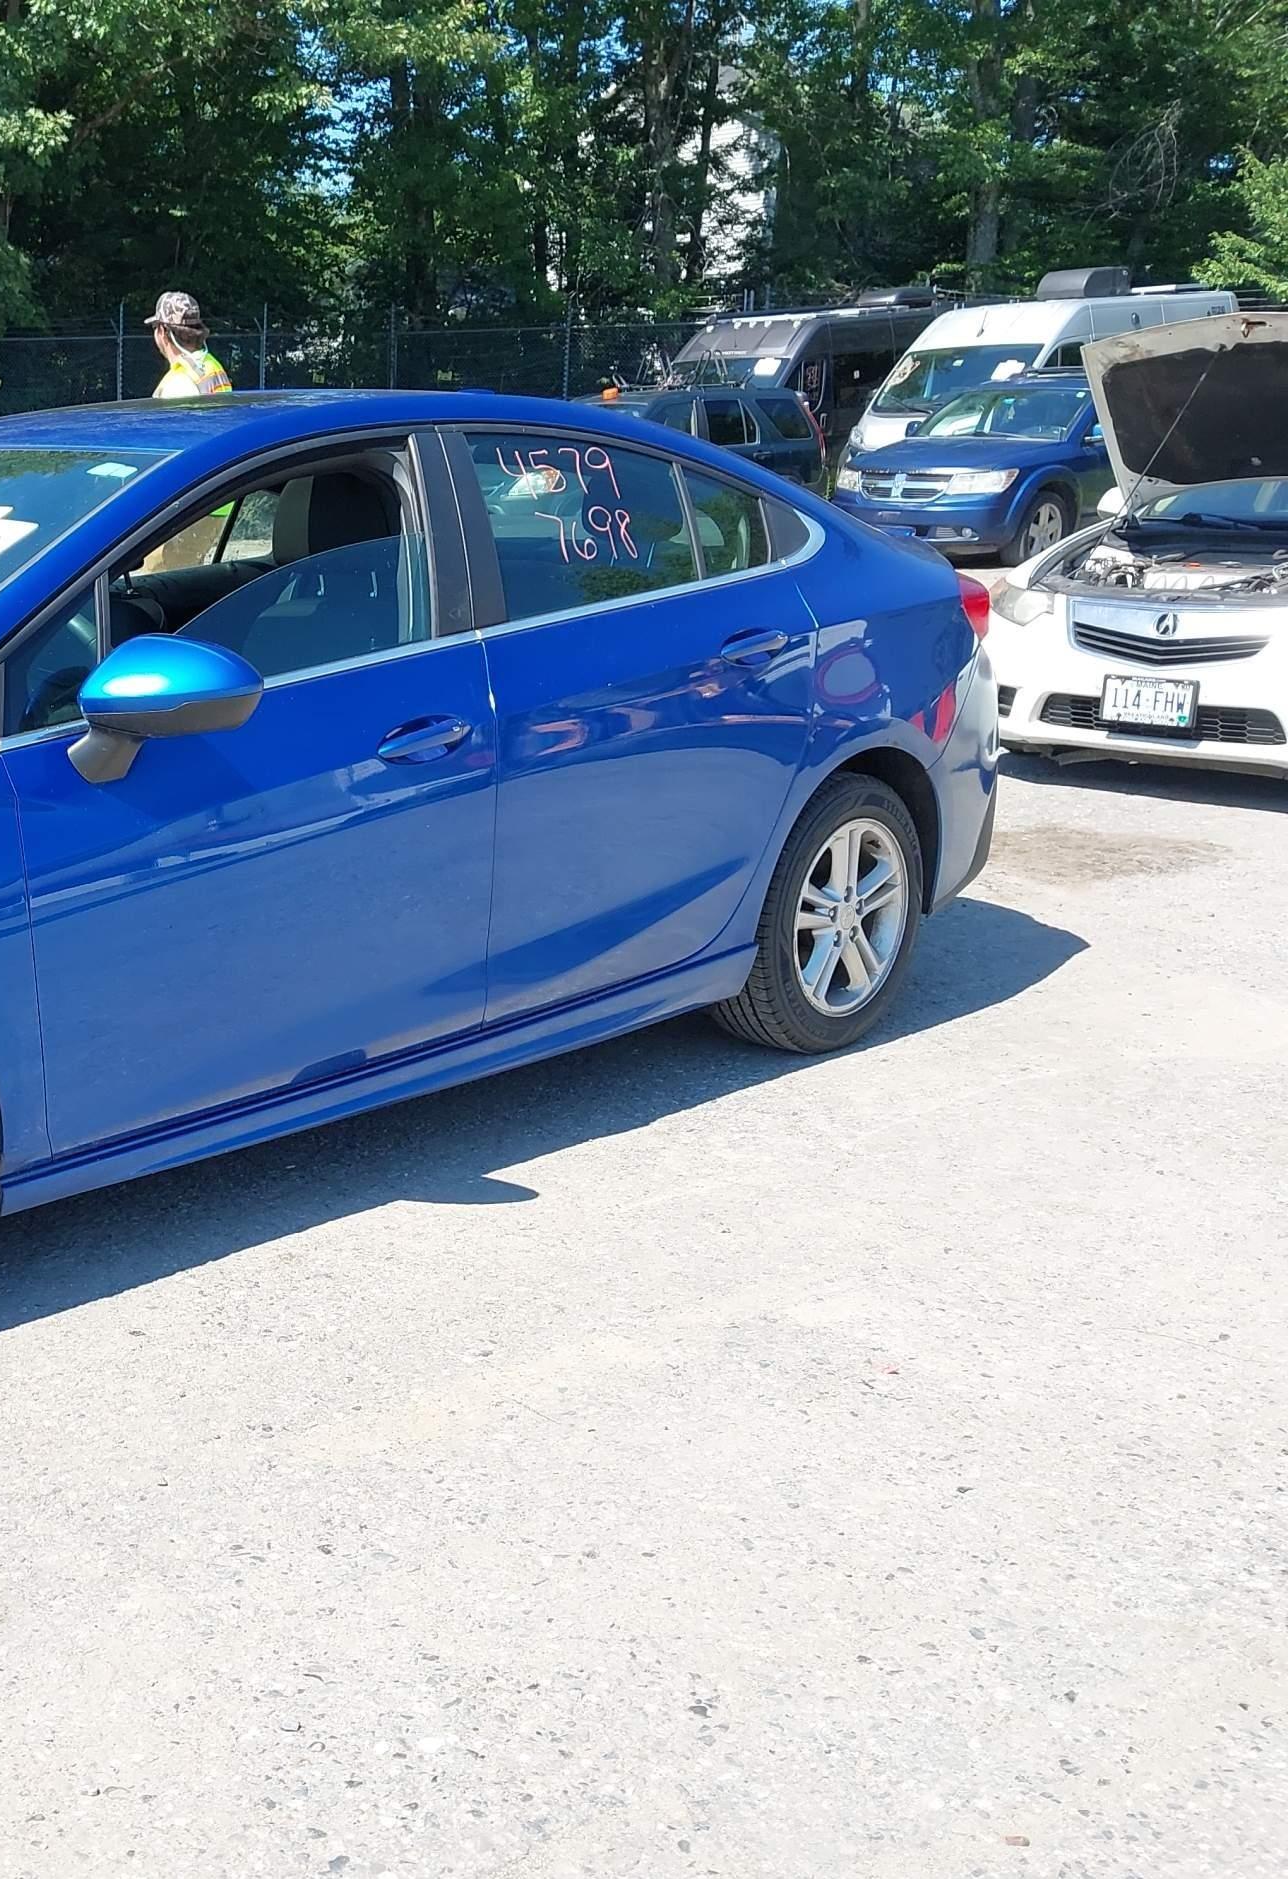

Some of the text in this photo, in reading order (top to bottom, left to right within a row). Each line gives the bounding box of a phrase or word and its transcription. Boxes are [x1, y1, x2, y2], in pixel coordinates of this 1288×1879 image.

[496, 446, 621, 500] 4579
[535, 505, 638, 563] 7698
[1112, 688, 1187, 714] 114 FHW
[1135, 680, 1164, 690] MAINE
